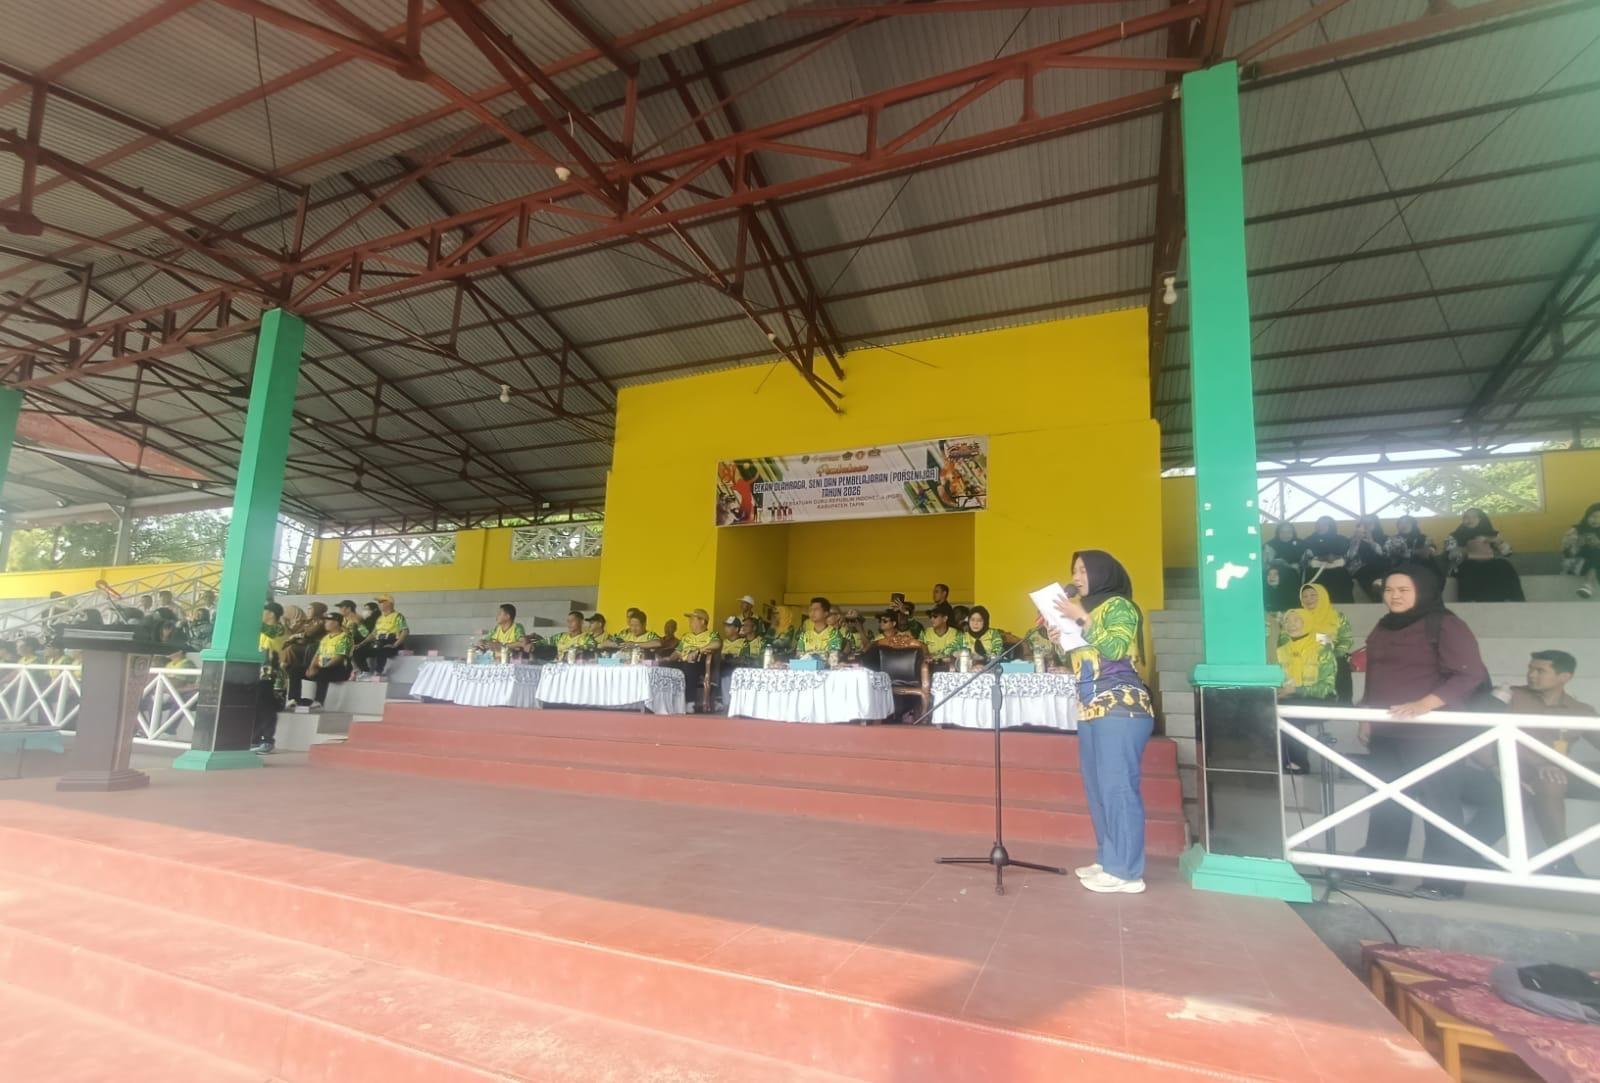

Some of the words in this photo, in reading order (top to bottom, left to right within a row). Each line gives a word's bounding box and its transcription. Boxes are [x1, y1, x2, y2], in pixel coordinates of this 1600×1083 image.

[754, 482, 774, 493] PEKAN
[808, 479, 823, 489] SENI
[824, 478, 837, 487] DAN
[838, 473, 888, 487] PEMBELAJARAN
[889, 467, 939, 484] (PORSENIJAR)
[821, 487, 842, 498] TAHUN
[843, 486, 861, 497] 2026
